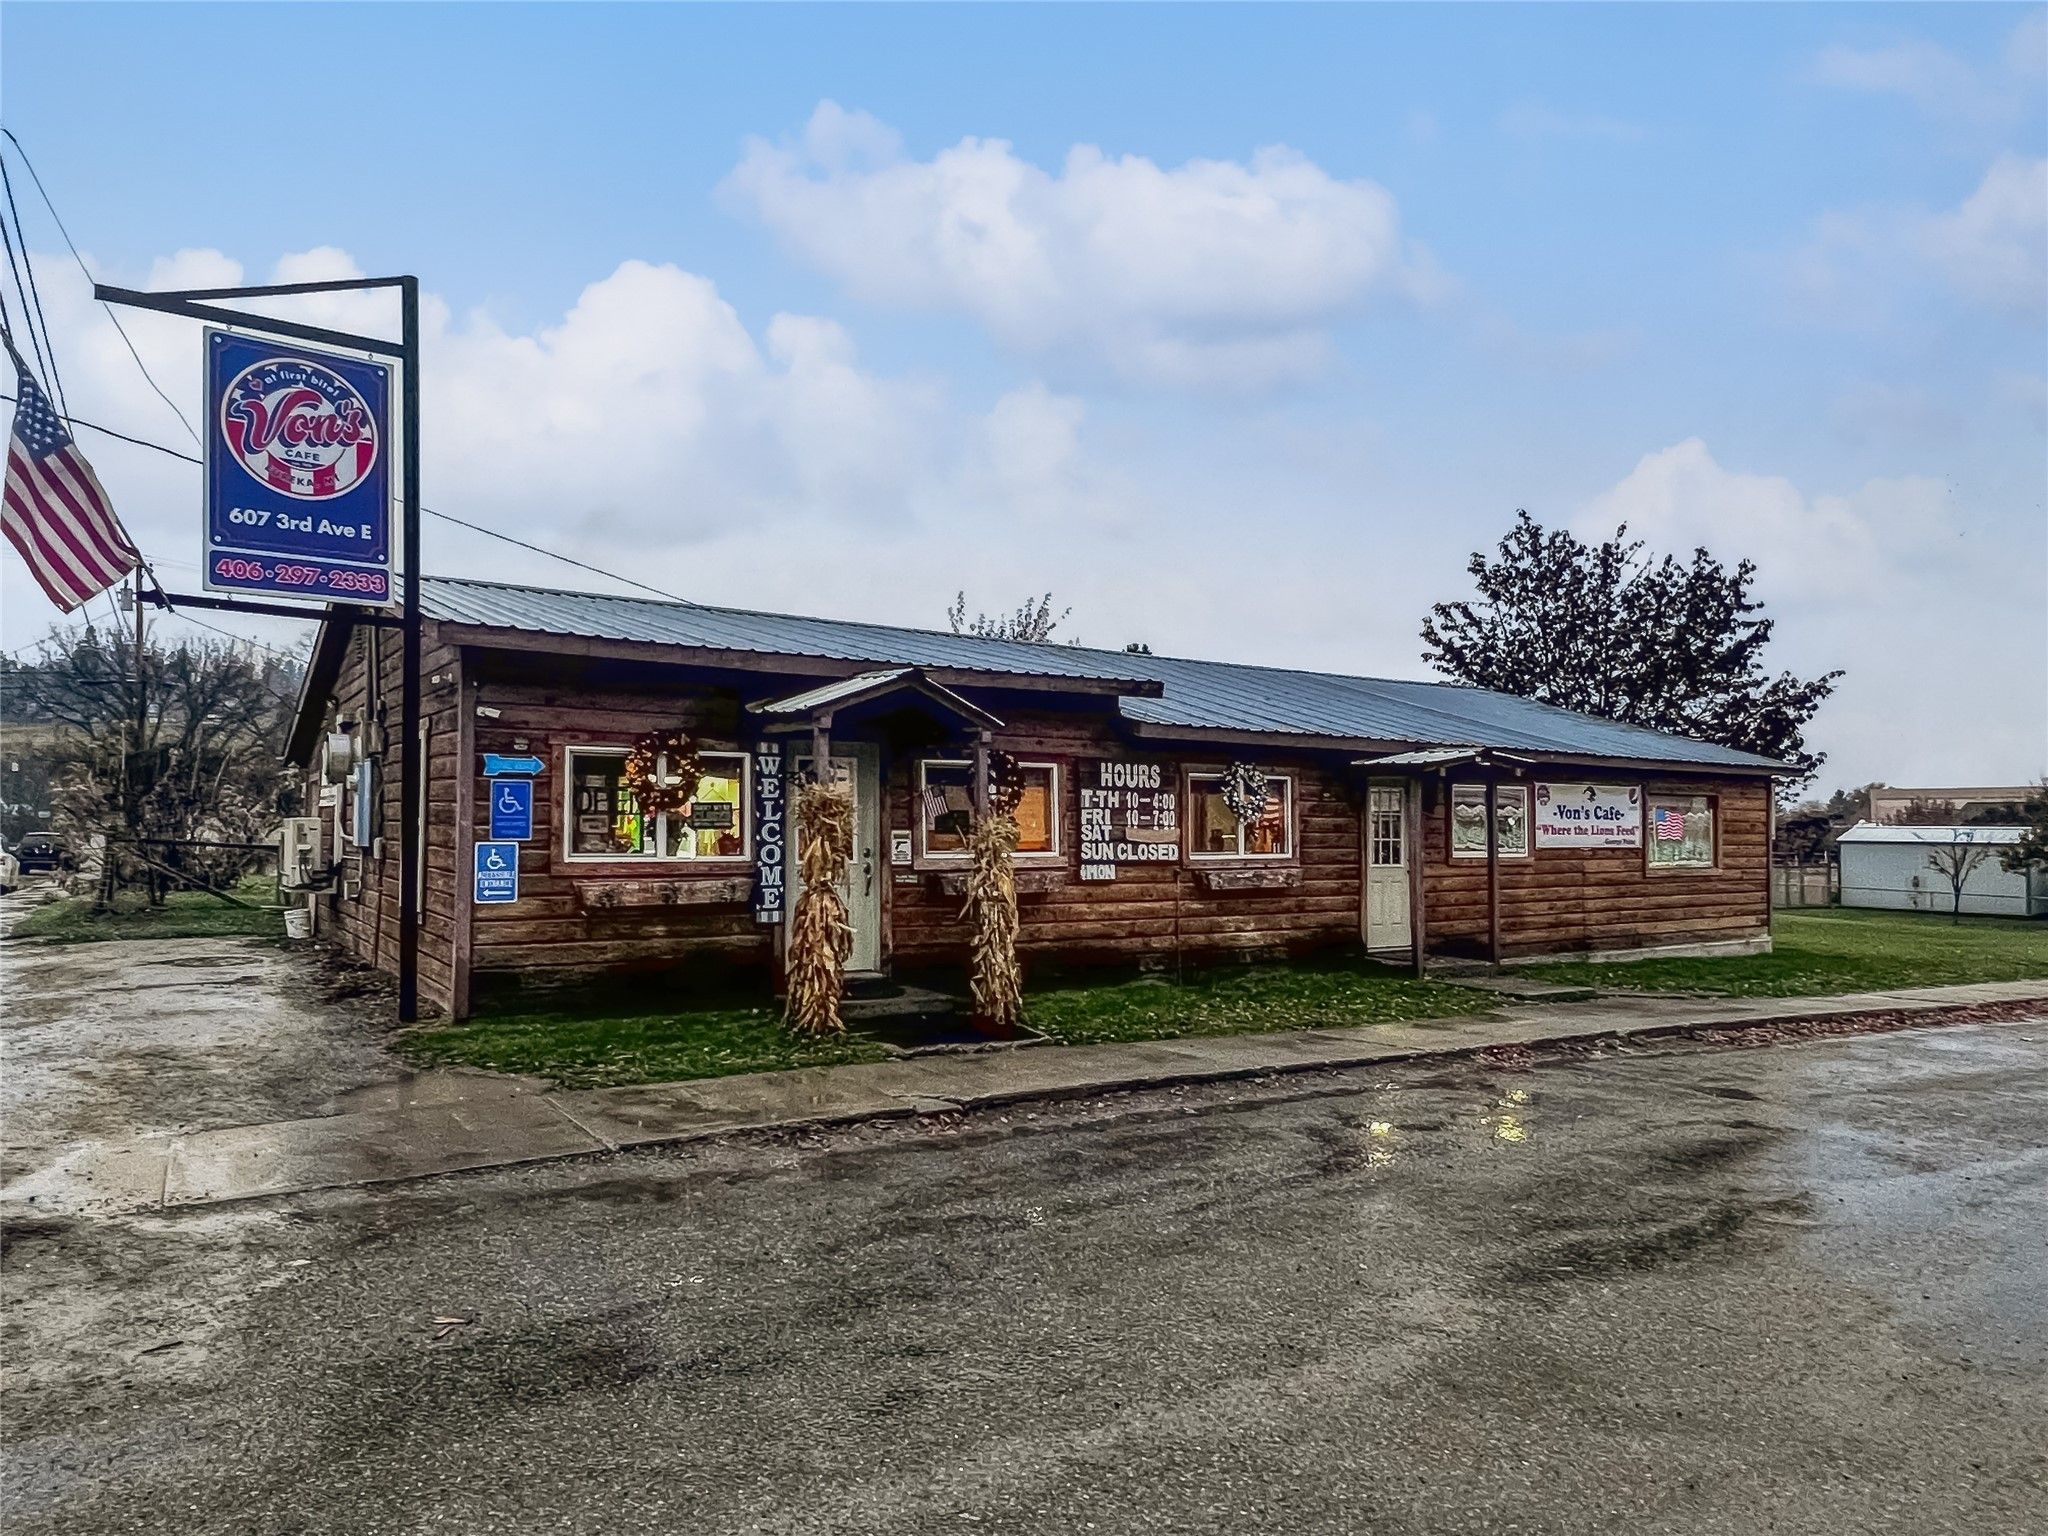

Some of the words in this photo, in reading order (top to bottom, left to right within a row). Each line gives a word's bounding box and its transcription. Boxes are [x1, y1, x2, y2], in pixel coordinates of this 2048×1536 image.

[280, 370, 306, 380] first
[232, 389, 364, 453] Von's
[285, 449, 320, 462] CAFE
[229, 508, 271, 526] 607
[276, 514, 312, 533] 3rd
[317, 519, 356, 538] Ave
[361, 525, 372, 540] E
[1101, 762, 1160, 788] HOURS
[1081, 789, 1119, 808] T-TH
[1081, 809, 1111, 825] FRI
[758, 756, 782, 909] WELCOME
[1081, 825, 1112, 841] SAT
[1574, 825, 1589, 836] the
[1081, 843, 1114, 860] SUN
[1117, 843, 1178, 860] CLOSED
